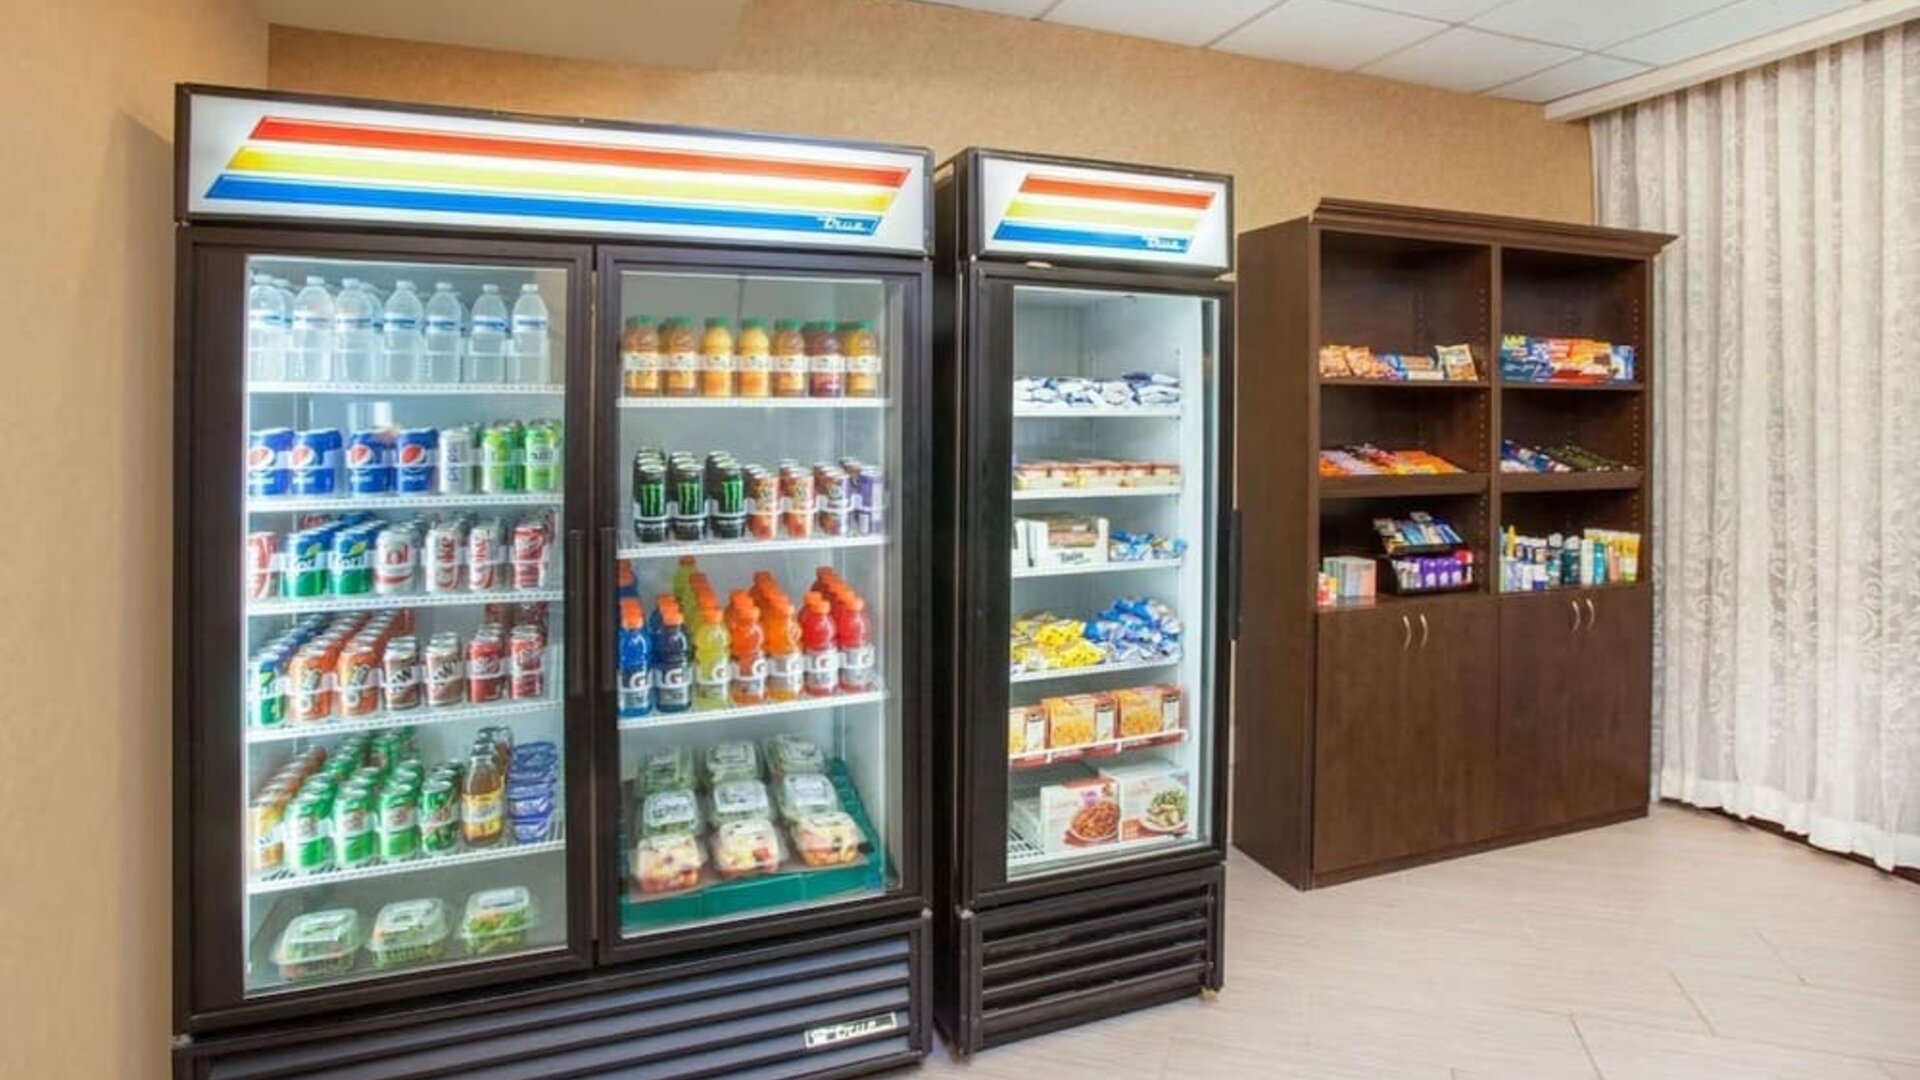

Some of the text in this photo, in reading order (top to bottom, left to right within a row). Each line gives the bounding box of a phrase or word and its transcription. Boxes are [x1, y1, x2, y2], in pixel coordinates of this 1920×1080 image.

[817, 213, 866, 232] True
[1141, 235, 1180, 250] True
[665, 667, 684, 686] G
[712, 664, 730, 684] G
[752, 657, 769, 678] G
[629, 670, 648, 691] G
